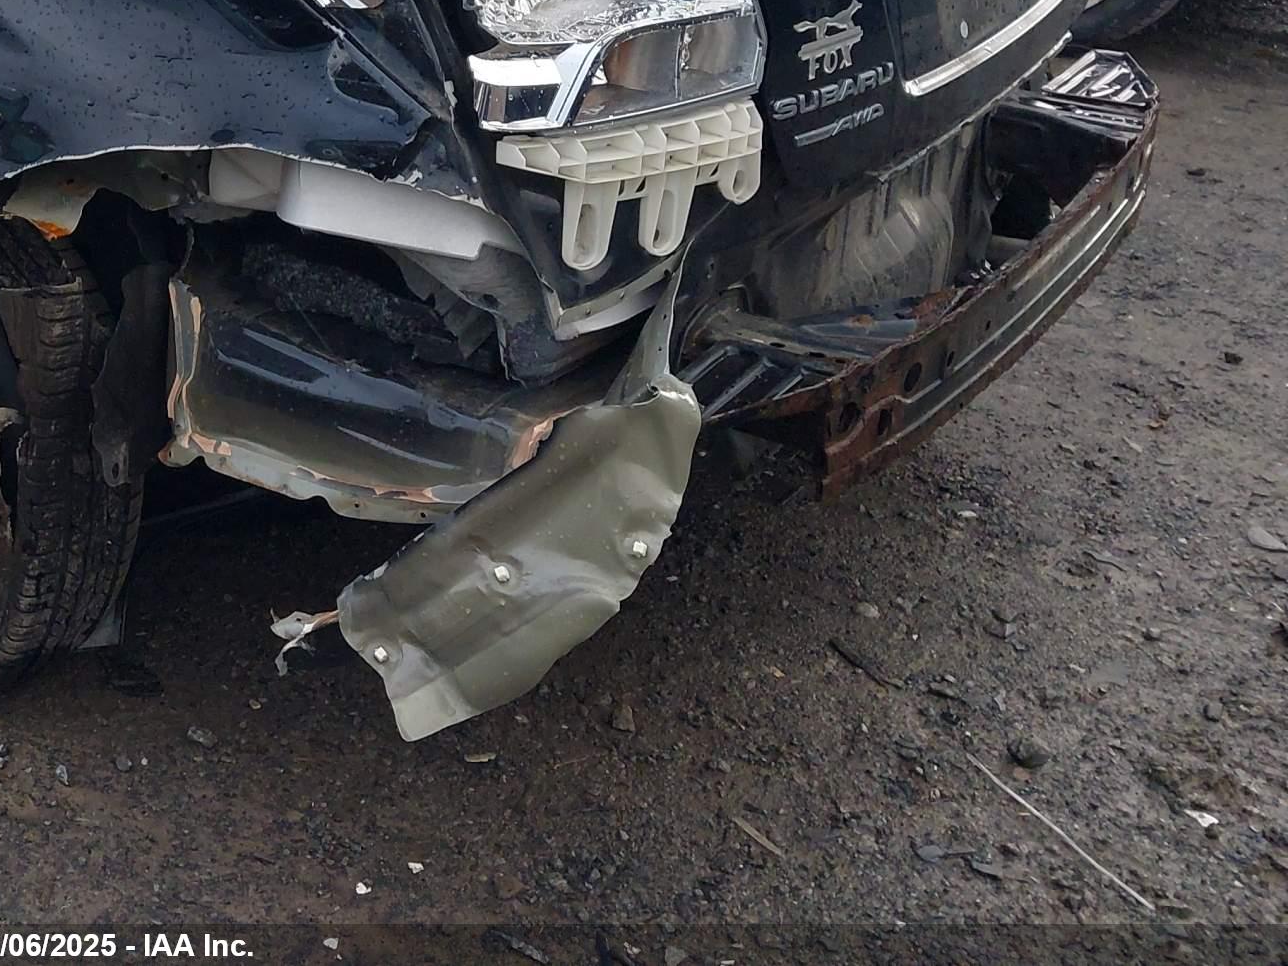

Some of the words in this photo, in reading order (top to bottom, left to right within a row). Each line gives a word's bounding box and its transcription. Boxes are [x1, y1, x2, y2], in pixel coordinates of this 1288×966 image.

[807, 44, 853, 81] FOX
[771, 61, 894, 121] SUBARU
[831, 102, 885, 137] AWD
